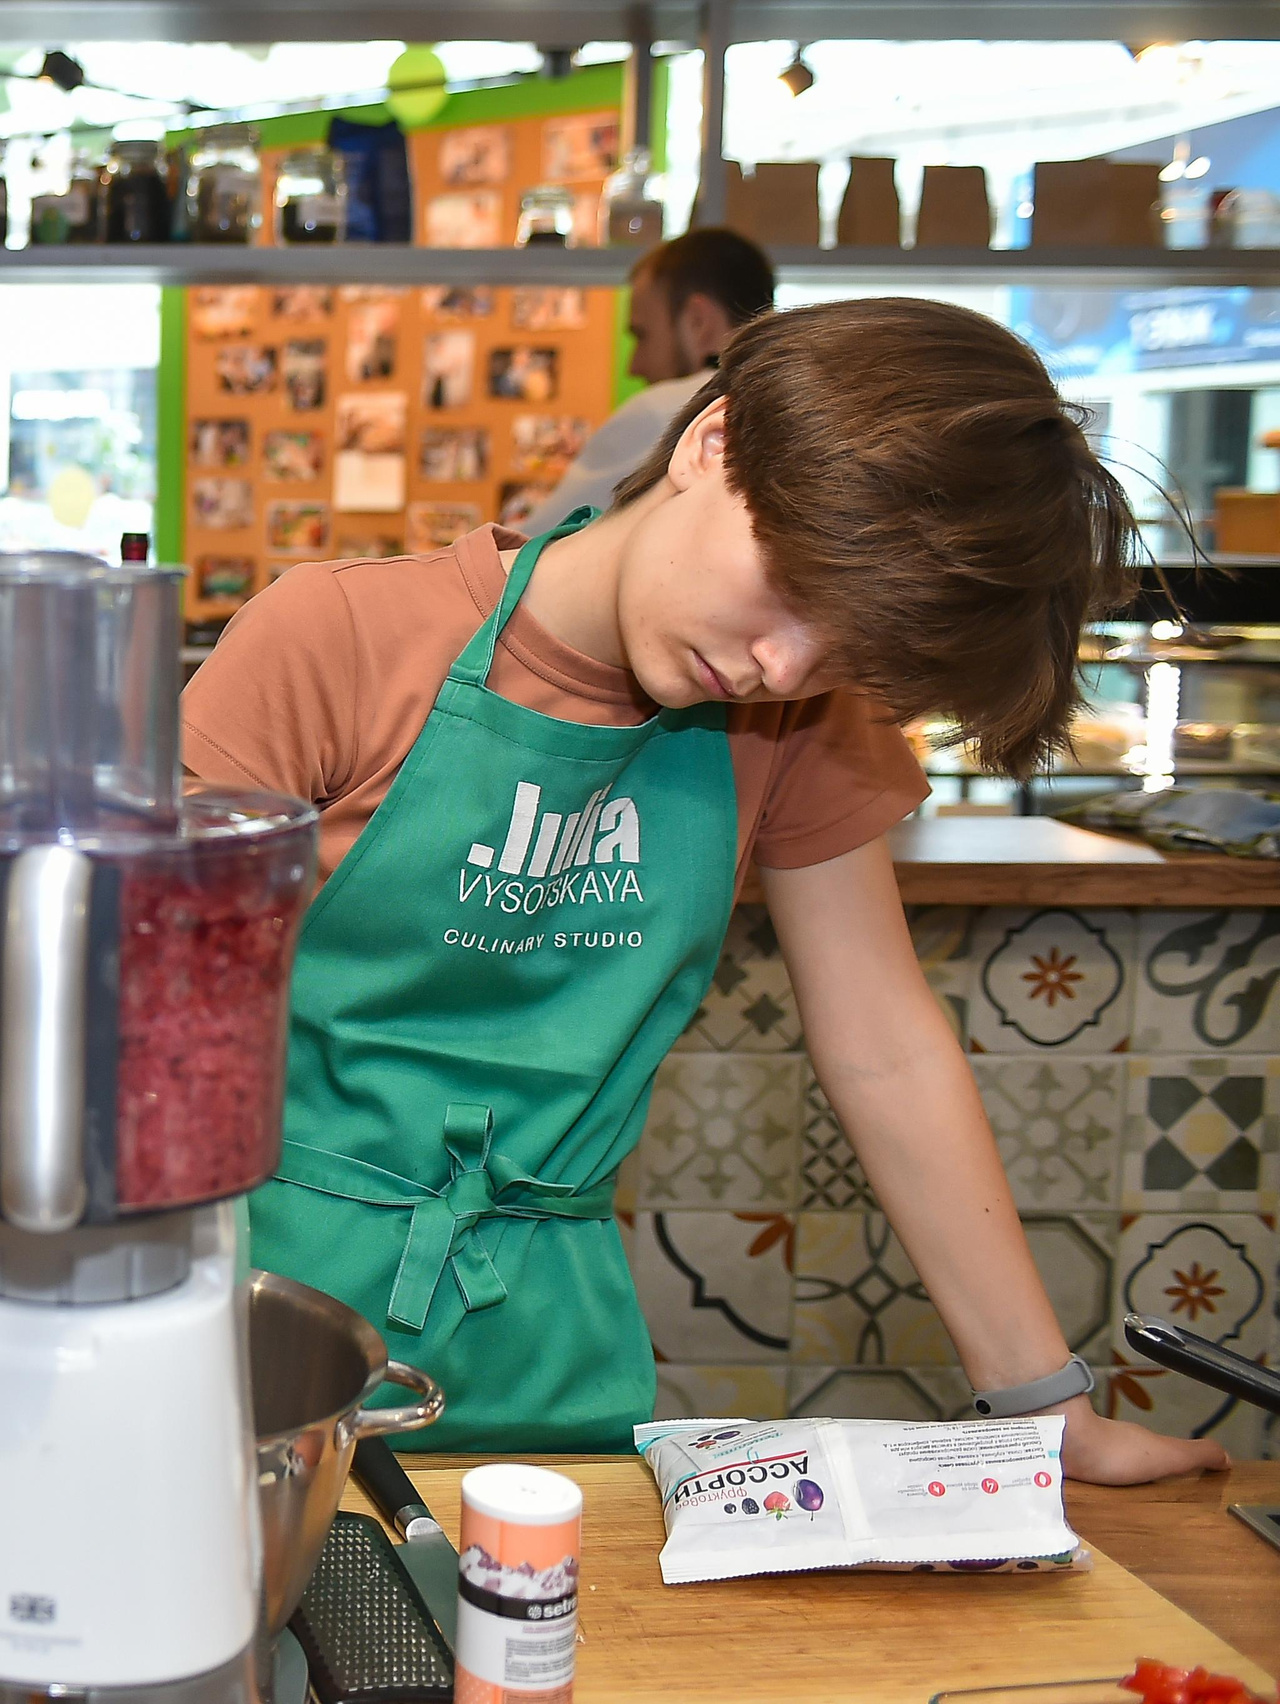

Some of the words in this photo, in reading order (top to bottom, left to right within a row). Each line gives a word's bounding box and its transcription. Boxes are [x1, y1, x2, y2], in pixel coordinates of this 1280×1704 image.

[467, 781, 640, 877] Julia
[458, 868, 644, 915] VYSOTSKAYA
[443, 929, 545, 954] CULINARY
[554, 931, 642, 948] STUDIO
[674, 1456, 809, 1504] АССОРТИ
